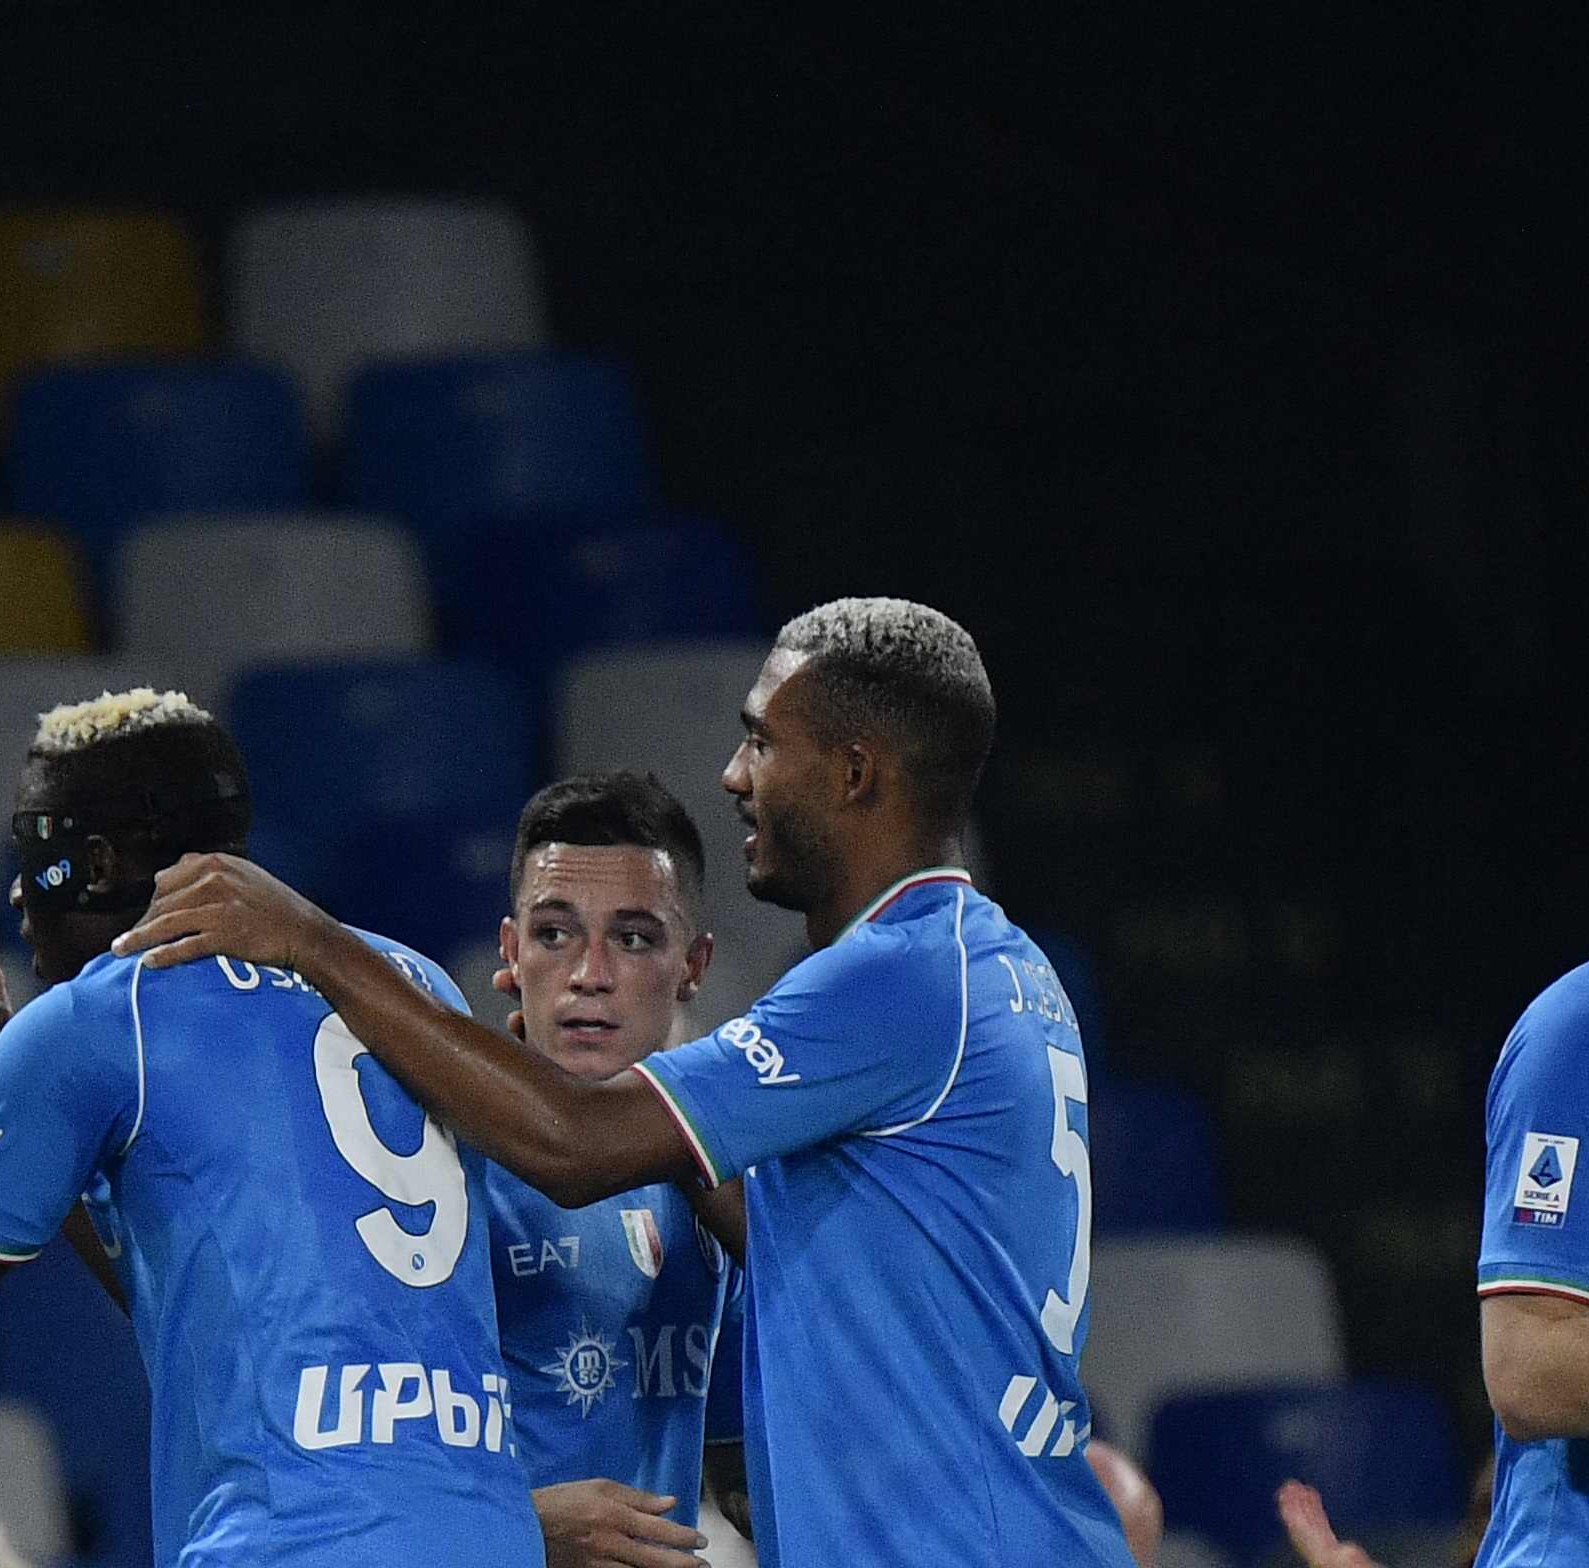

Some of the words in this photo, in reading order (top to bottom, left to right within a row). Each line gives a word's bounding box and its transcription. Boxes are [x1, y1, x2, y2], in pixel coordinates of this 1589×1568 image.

[719, 1016, 802, 1085] ebay
[314, 1010, 470, 1289] 9
[1041, 1045, 1091, 1356] 5
[1533, 1211, 1558, 1224] TIM
[508, 1236, 580, 1277] EA7
[627, 1326, 709, 1399] MS
